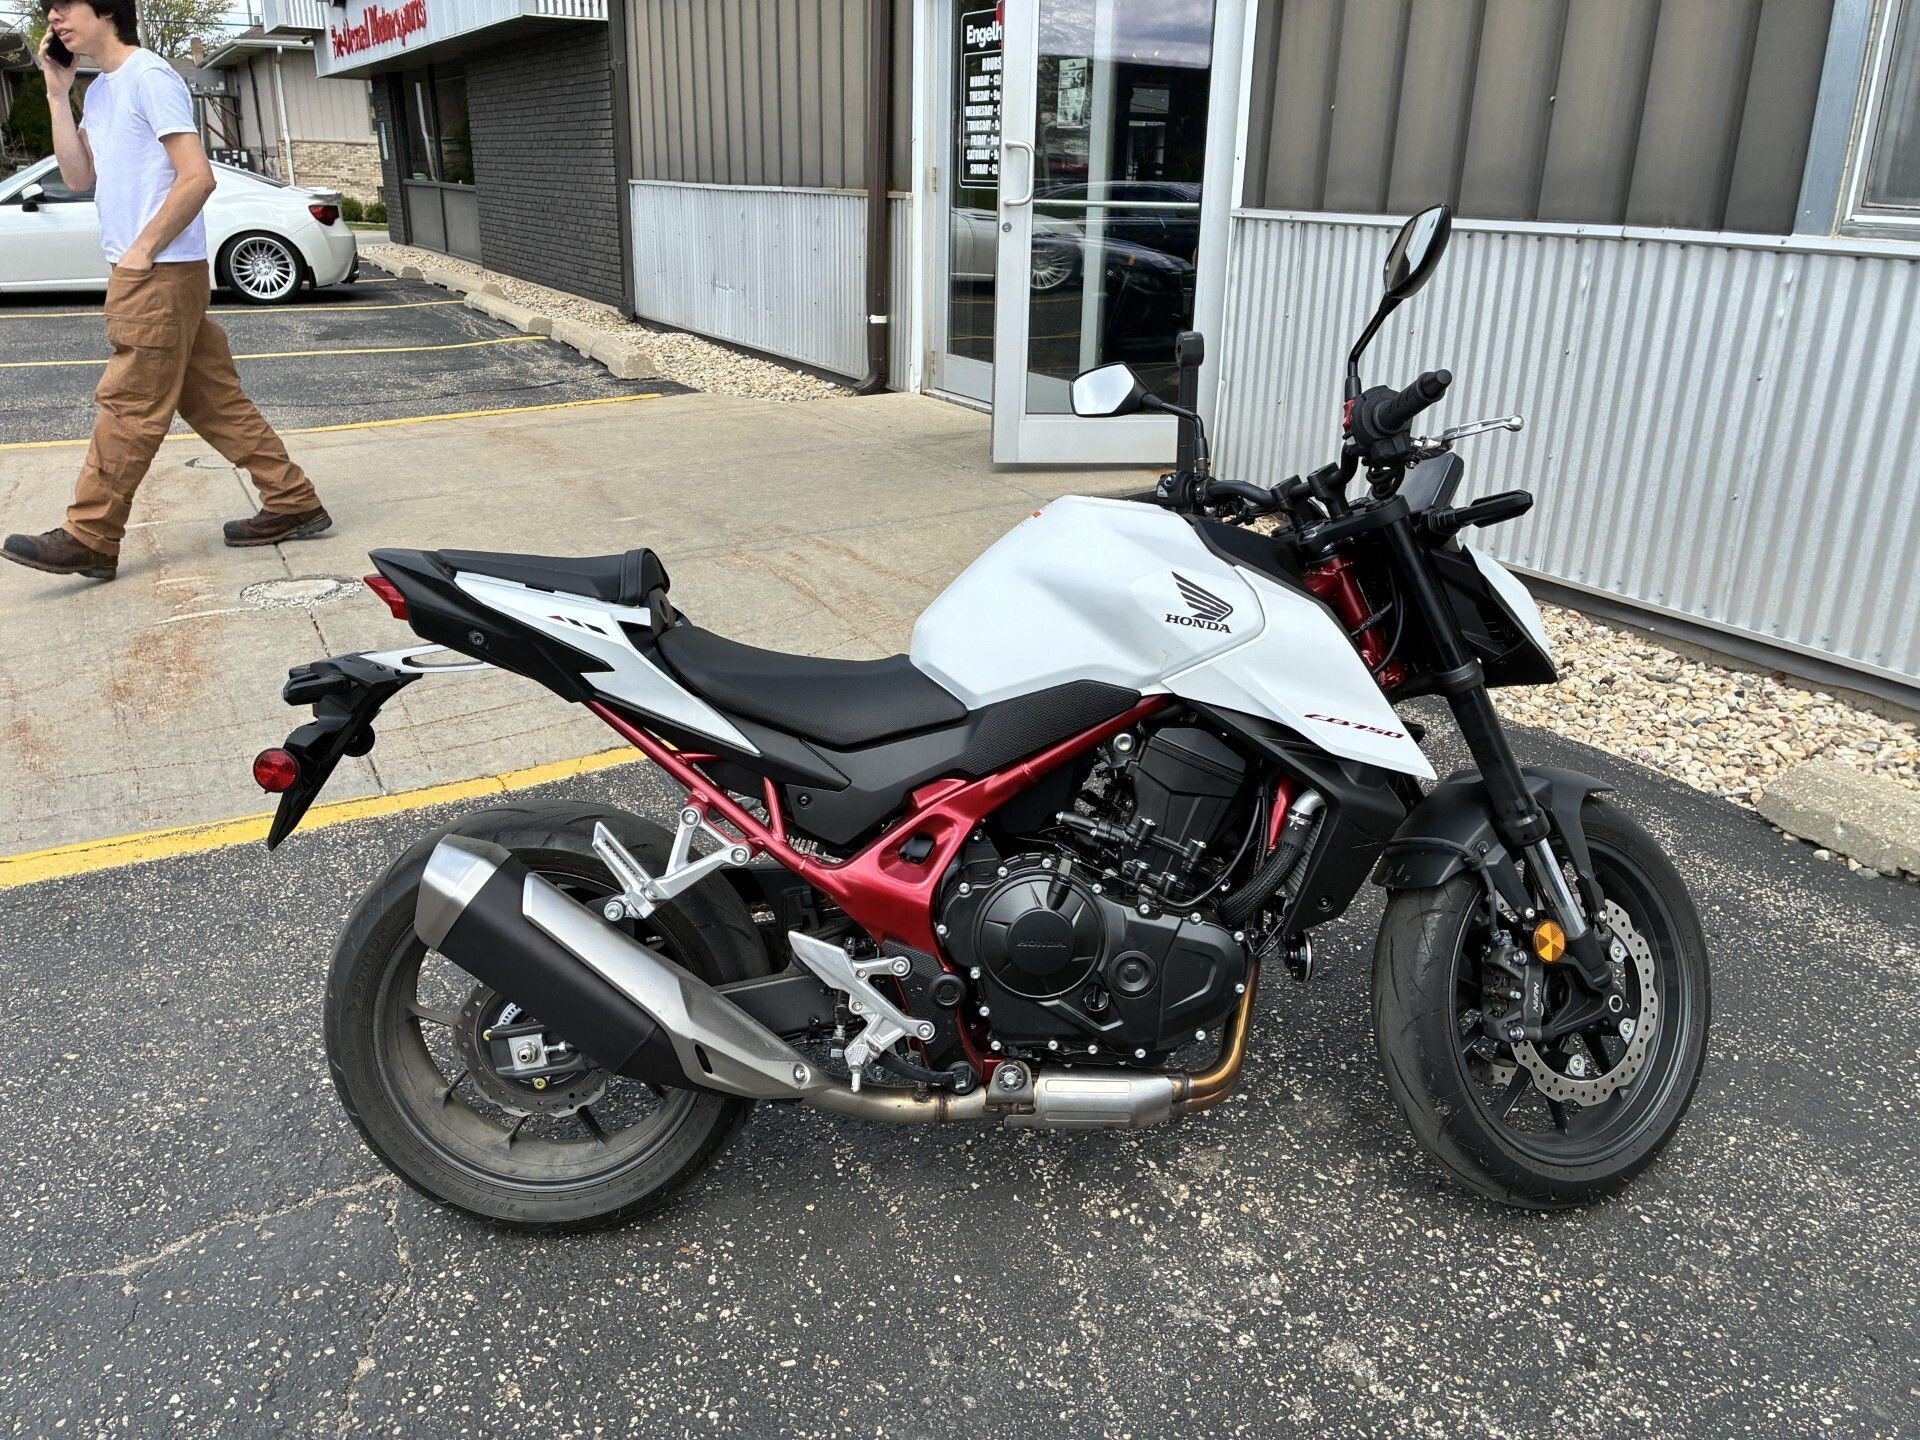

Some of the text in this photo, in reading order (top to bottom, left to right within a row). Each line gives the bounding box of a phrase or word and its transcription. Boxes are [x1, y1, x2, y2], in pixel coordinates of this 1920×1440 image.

[969, 90, 990, 102] TUESDAY
[965, 105, 994, 117] WEDNESDAY
[966, 120, 991, 131] THURSDAY
[970, 134, 987, 146] FRIDAY
[966, 149, 990, 160] SATURDAY
[970, 163, 988, 175] SUNDAY
[1164, 613, 1233, 634] HONDA
